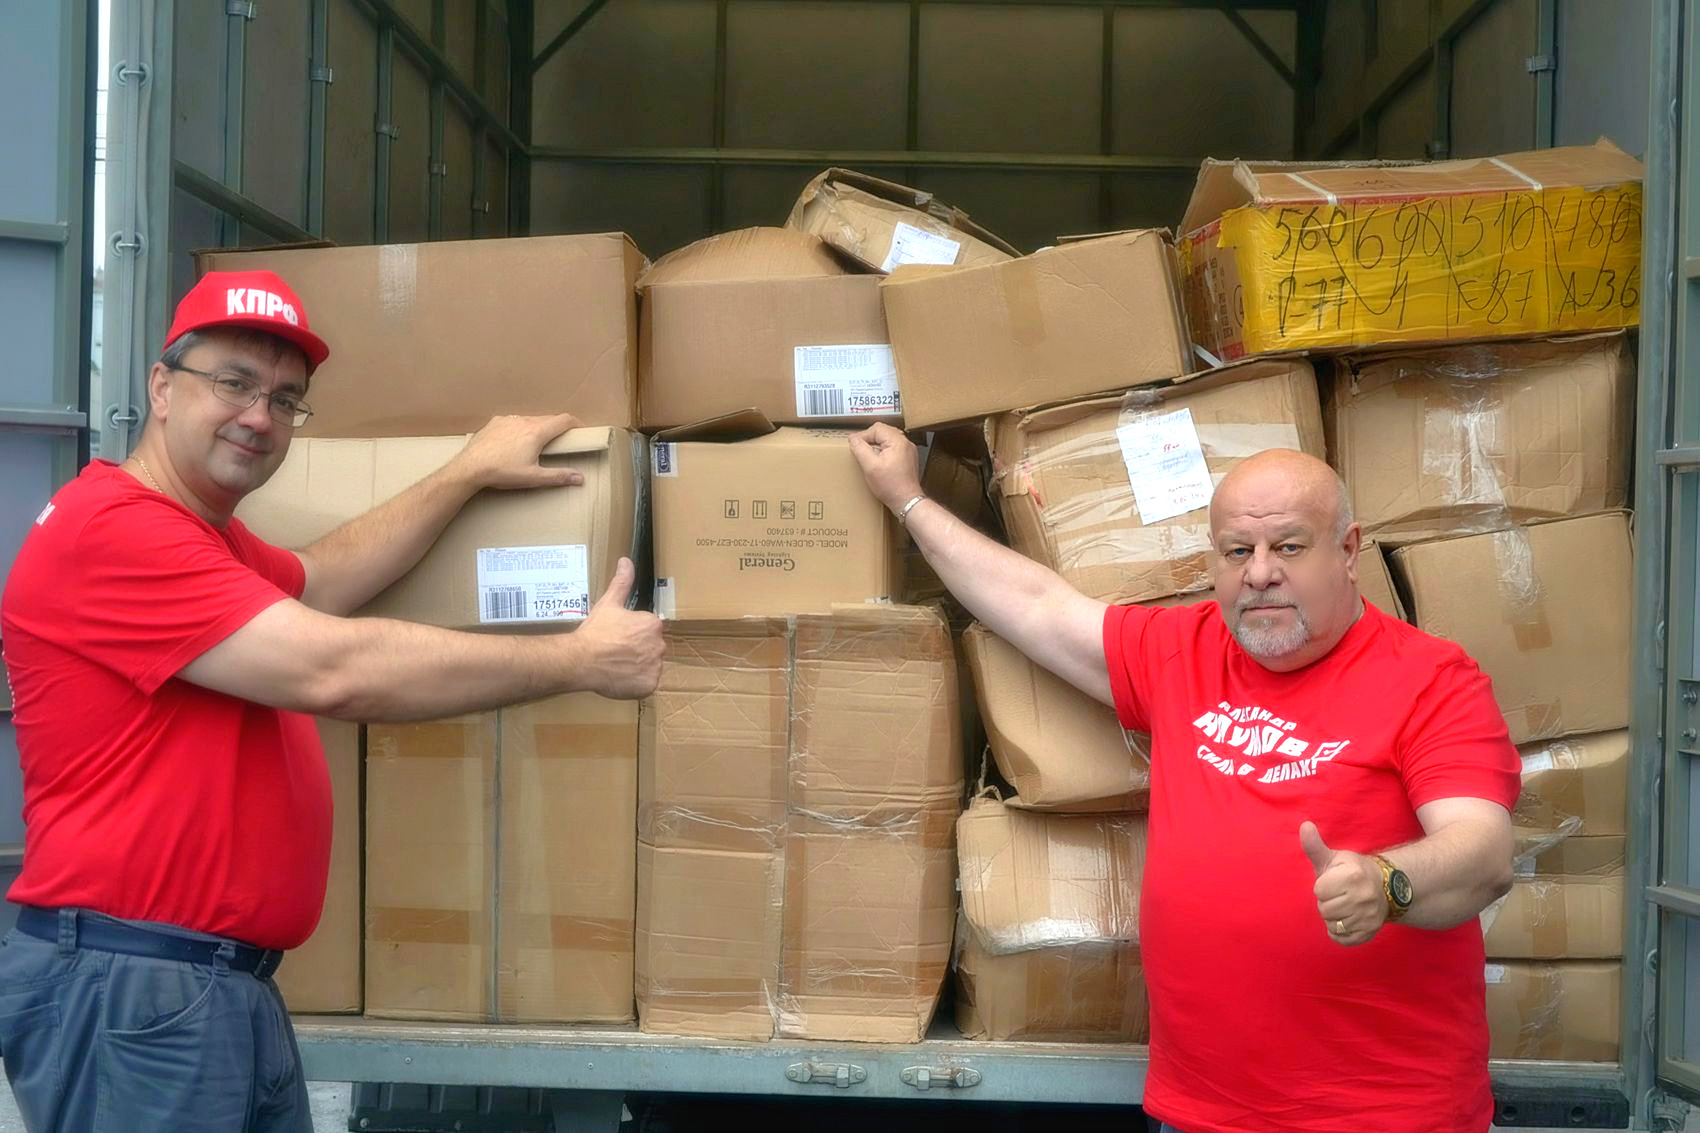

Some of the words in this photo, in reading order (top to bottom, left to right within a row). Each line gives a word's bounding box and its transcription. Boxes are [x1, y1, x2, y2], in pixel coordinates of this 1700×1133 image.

[226, 287, 299, 327] КПРФ
[847, 395, 894, 407] 17586322
[766, 527, 795, 537] 637400
[807, 527, 849, 537] PRODUCT
[739, 557, 796, 572] General
[534, 599, 581, 610] 17517456
[1197, 745, 1234, 776] СИЛА
[1237, 763, 1255, 775] В
[1257, 757, 1317, 784] ДЕЛАХ!
